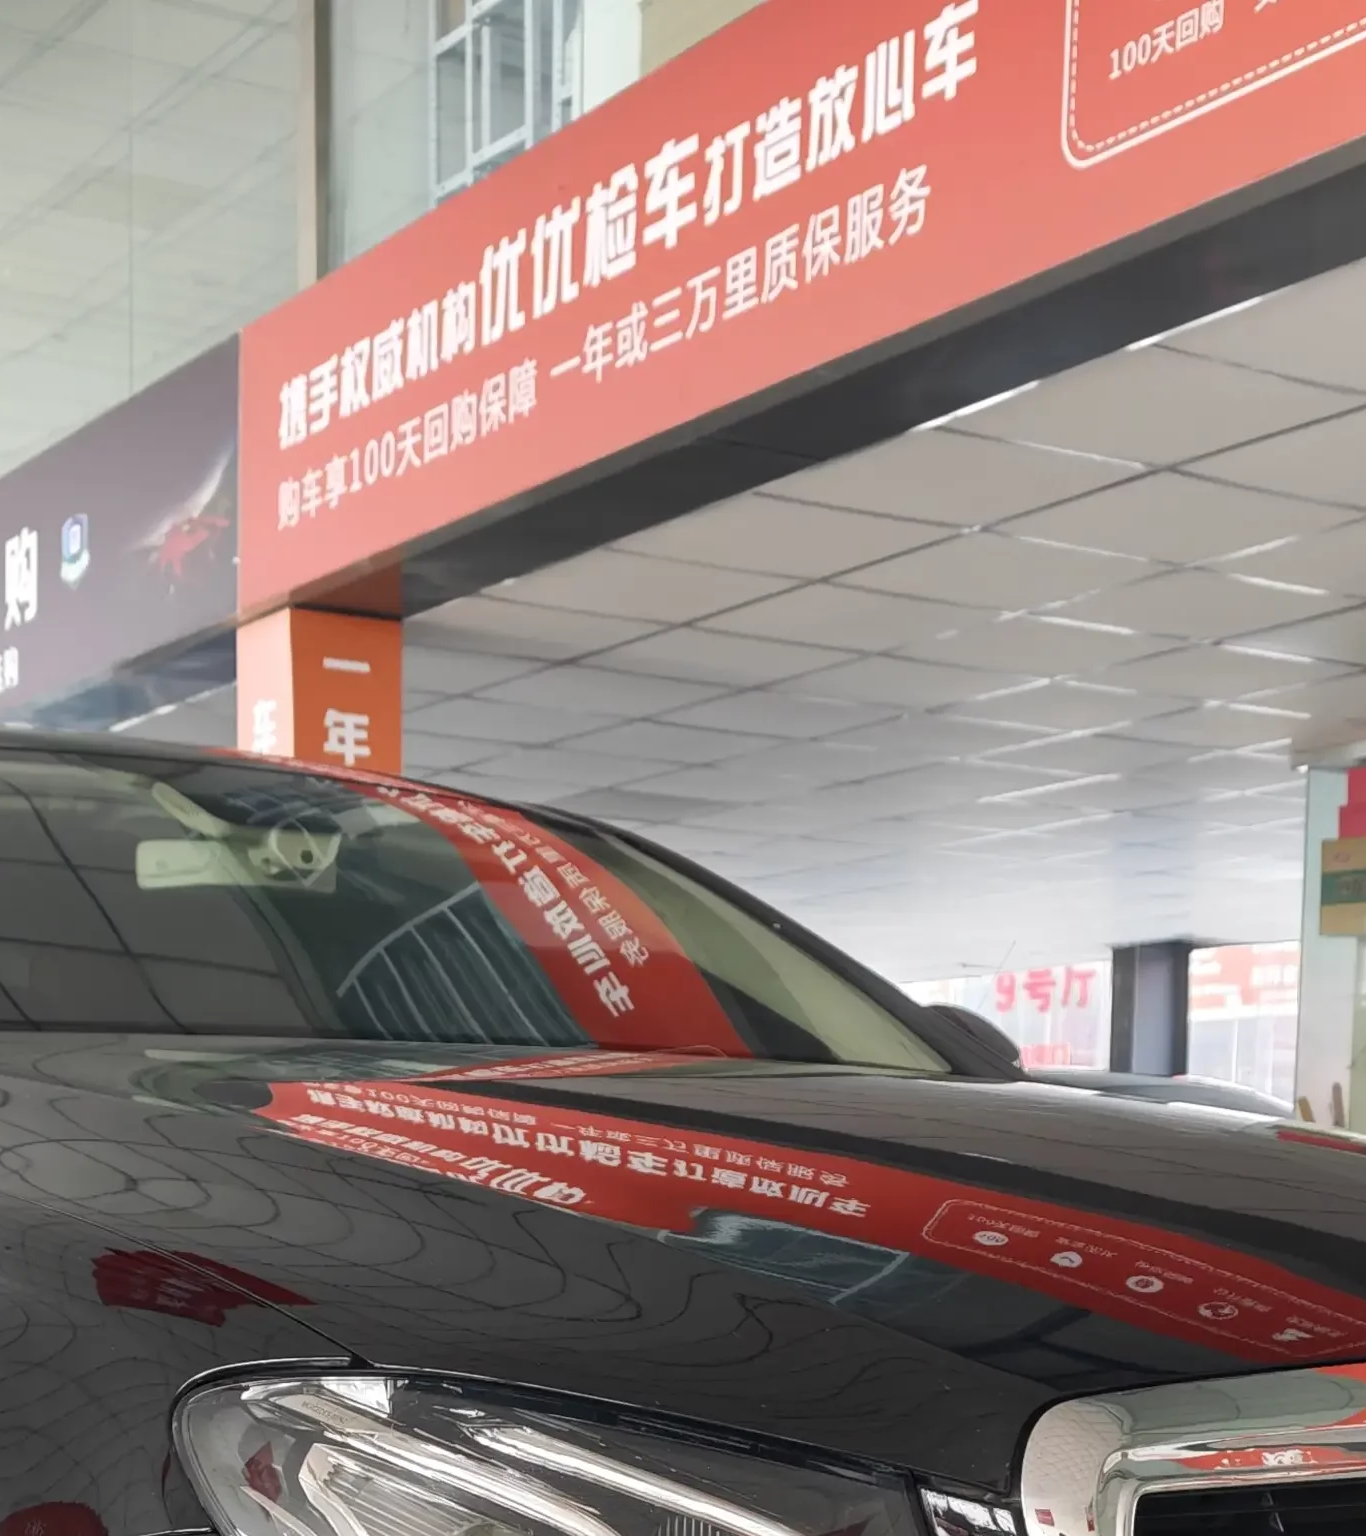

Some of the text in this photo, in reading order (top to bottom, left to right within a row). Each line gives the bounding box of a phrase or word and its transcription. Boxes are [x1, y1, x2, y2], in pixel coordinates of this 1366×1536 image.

[1109, 0, 1225, 80] 100天回购
[277, 164, 931, 531] 购车享100天回购保障 一年或三万里质保服务
[278, 0, 979, 448] 携手权威机构优优检车打造放心车
